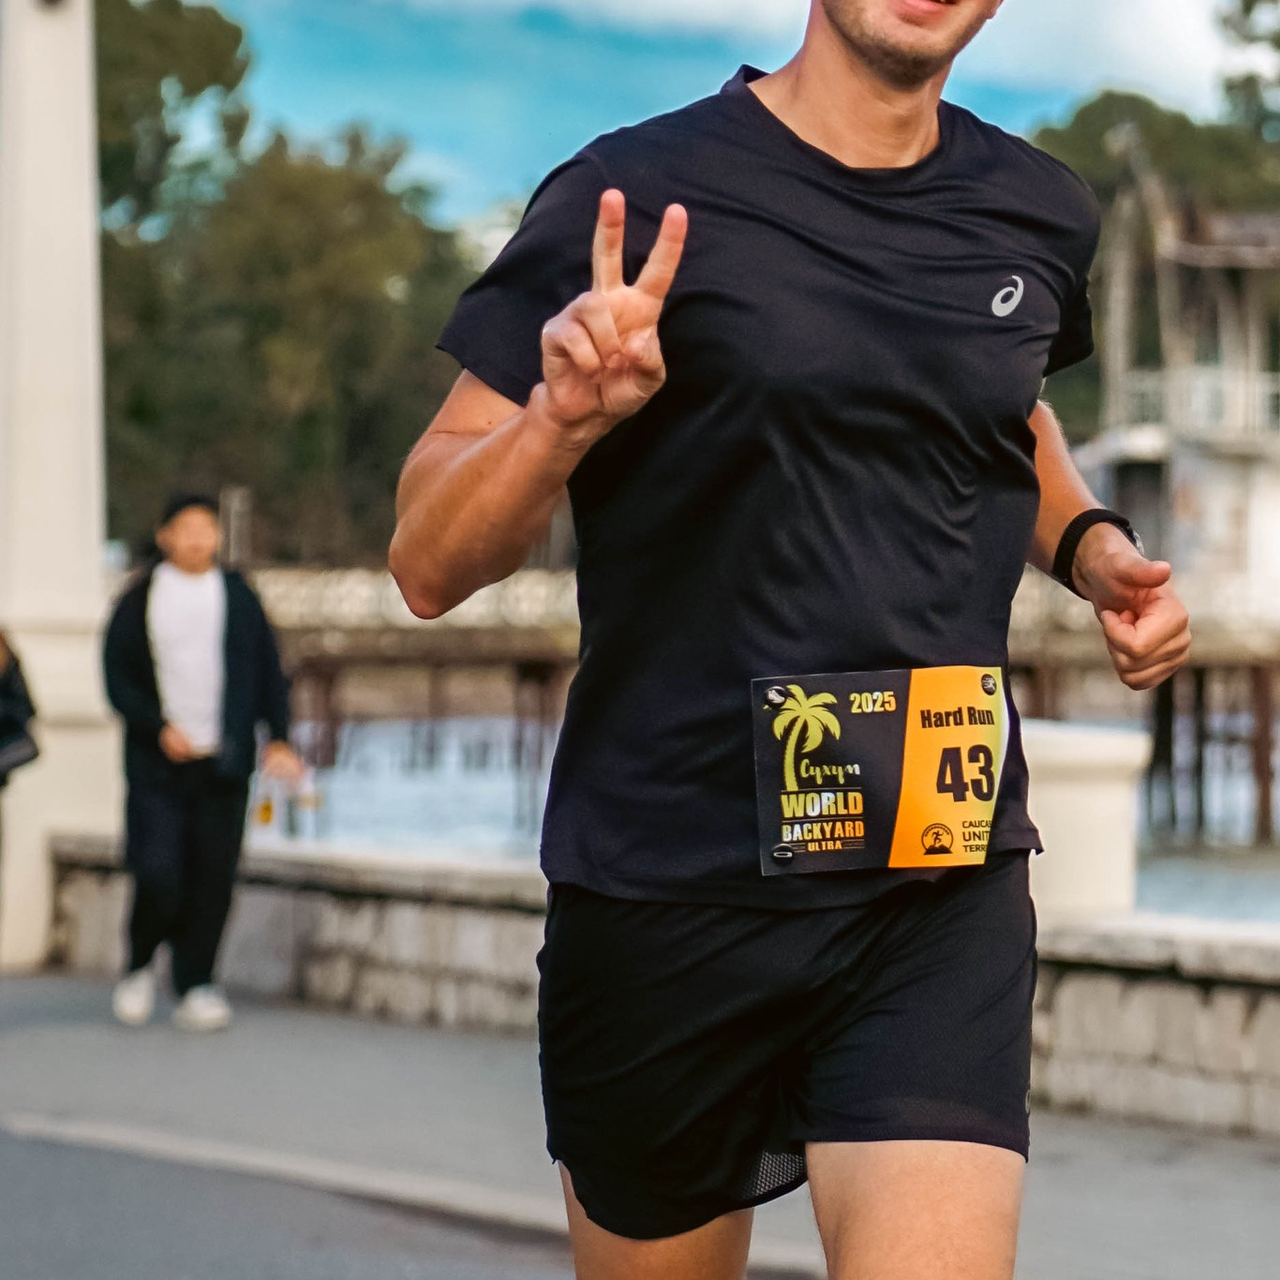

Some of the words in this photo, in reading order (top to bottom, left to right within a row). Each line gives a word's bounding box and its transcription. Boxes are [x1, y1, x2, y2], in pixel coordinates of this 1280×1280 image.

[850, 691, 896, 714] 2025
[920, 707, 963, 729] Hard
[968, 706, 995, 725] Run
[936, 744, 996, 802] 43
[781, 792, 864, 818] WORLD
[782, 820, 865, 843] BACKYARD
[807, 840, 842, 852] ULTRA
[963, 844, 987, 853] TERR
